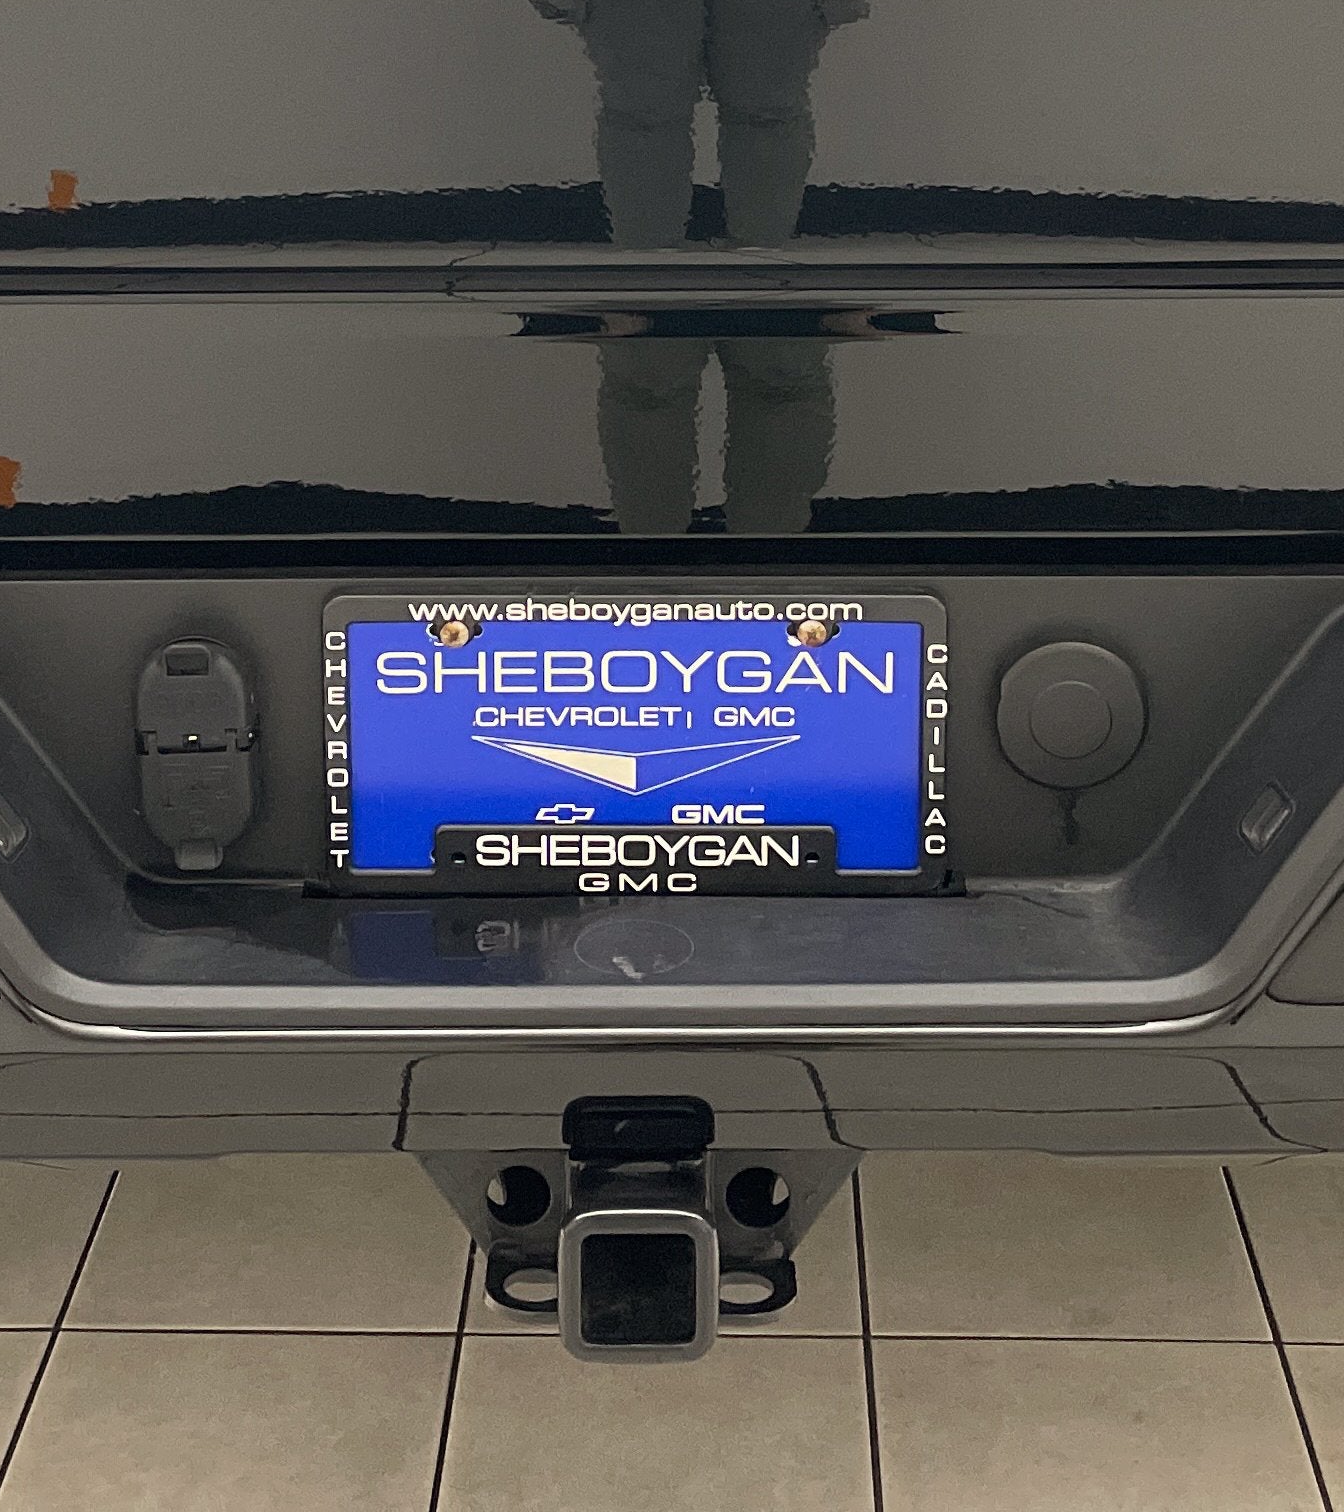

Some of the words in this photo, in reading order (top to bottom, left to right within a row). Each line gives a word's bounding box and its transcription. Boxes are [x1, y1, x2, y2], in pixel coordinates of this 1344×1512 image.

[408, 598, 863, 627] www.sheboyganauto.com
[375, 650, 895, 695] SHEBOYGAN
[713, 706, 796, 728] GMC
[325, 631, 350, 869] CHEVROLET
[924, 644, 949, 856] CADILLAC
[671, 804, 765, 825] GMC
[475, 834, 800, 868] SHEBOYGAN
[578, 873, 698, 893] GMC
